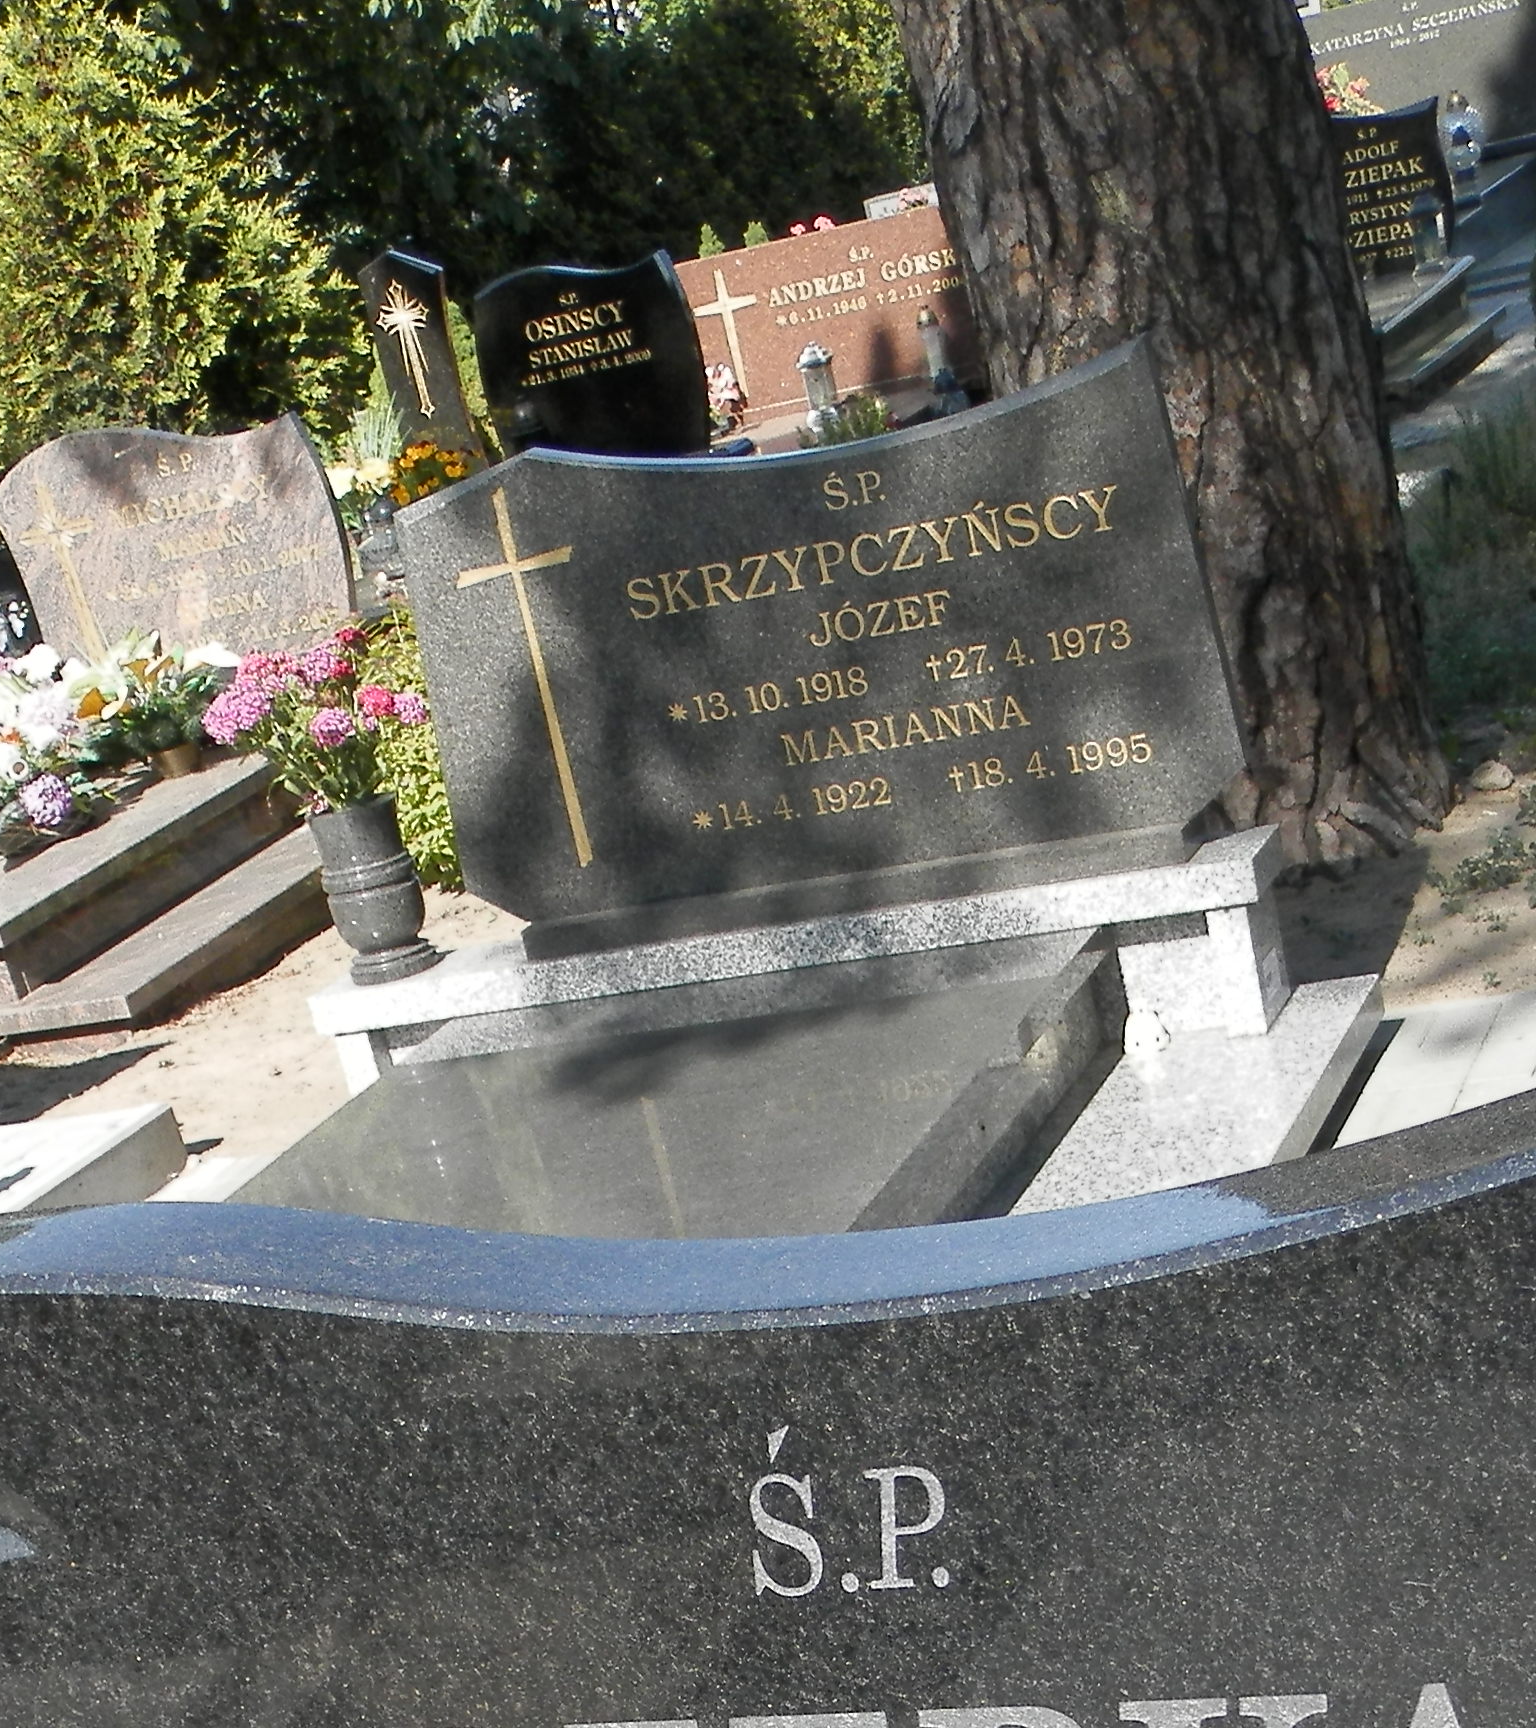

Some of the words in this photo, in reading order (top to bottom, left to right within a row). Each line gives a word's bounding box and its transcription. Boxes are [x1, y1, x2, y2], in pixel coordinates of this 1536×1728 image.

[1310, 23, 1404, 56] KATARZYNA
[1344, 140, 1399, 165] ADOLF
[1345, 156, 1424, 188] ZIEPAK
[1349, 200, 1412, 225] RYSTYN
[1349, 221, 1414, 248] ZIEPA
[768, 267, 867, 307] ANDRZEJ
[880, 248, 957, 282] GÓRSK
[823, 471, 887, 511] Ś.P.
[626, 485, 1117, 620] SKRZYPCZYŃSCY
[809, 589, 950, 648] JÓZEF
[796, 665, 869, 706] 1918
[1047, 619, 1132, 662] 1973
[780, 694, 1031, 766] MARIANNA
[812, 776, 892, 816] 1922
[1066, 732, 1153, 775] 1995
[748, 1426, 952, 1597] Ś.P.
